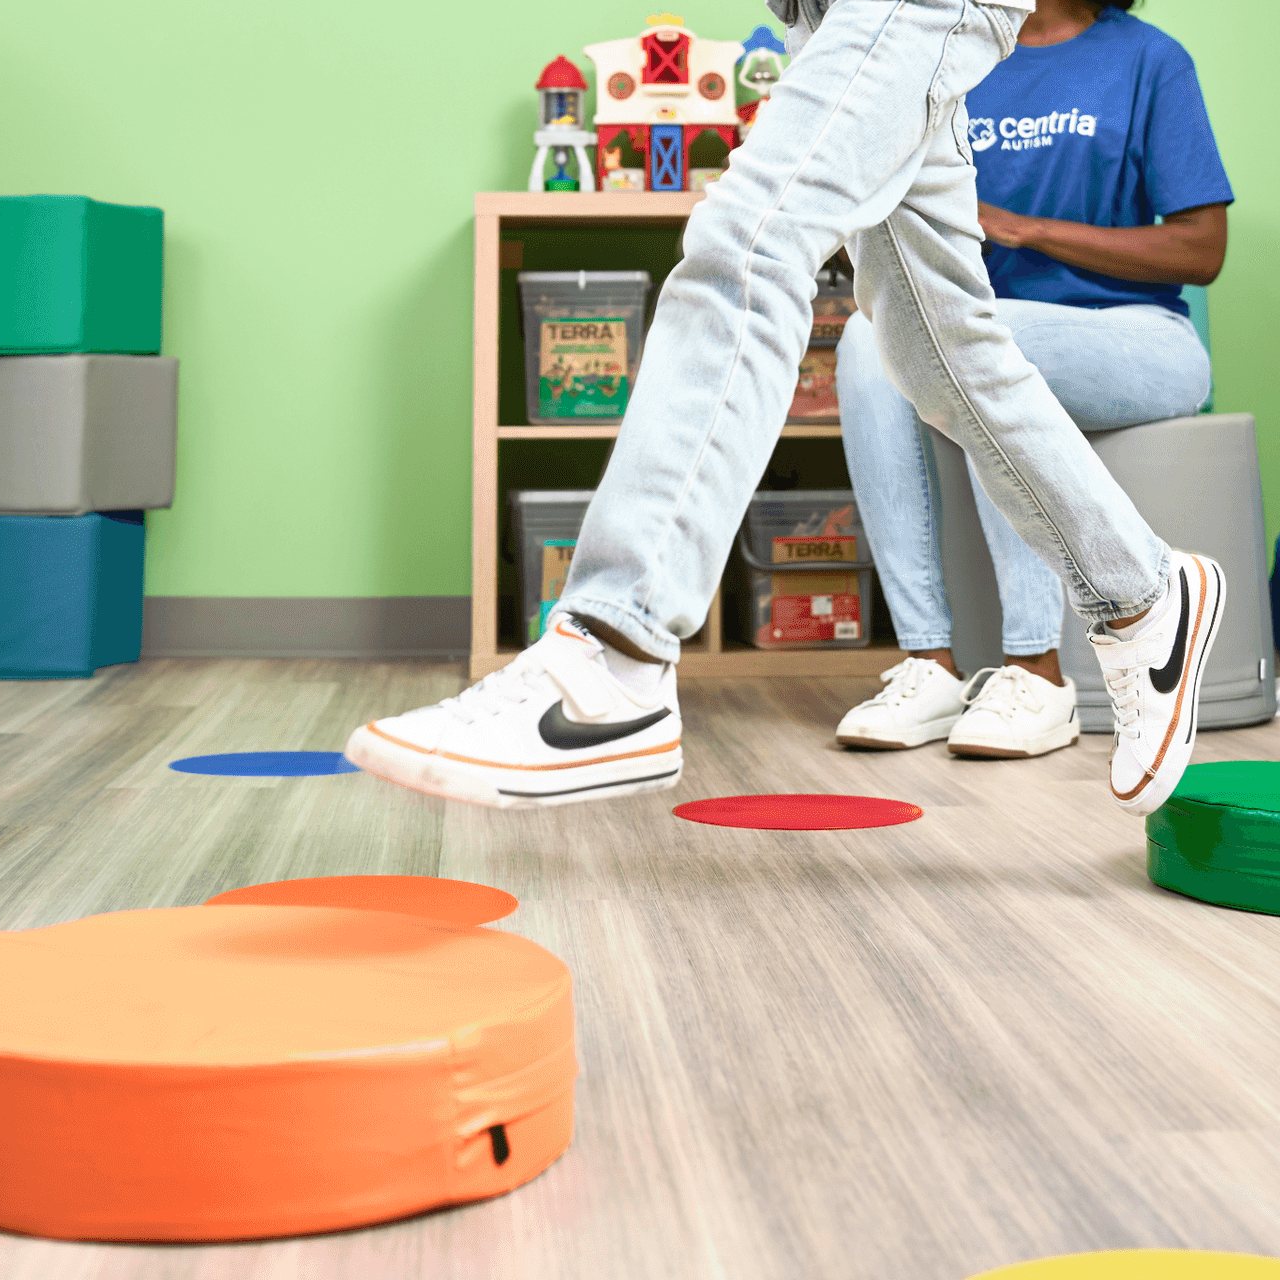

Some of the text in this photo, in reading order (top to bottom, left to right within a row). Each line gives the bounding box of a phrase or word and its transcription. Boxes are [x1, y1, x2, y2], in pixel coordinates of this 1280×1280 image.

[999, 107, 1097, 139] centria
[1000, 135, 1053, 151] AUTISM
[547, 324, 614, 340] TERRA
[785, 542, 844, 558] TERRA
